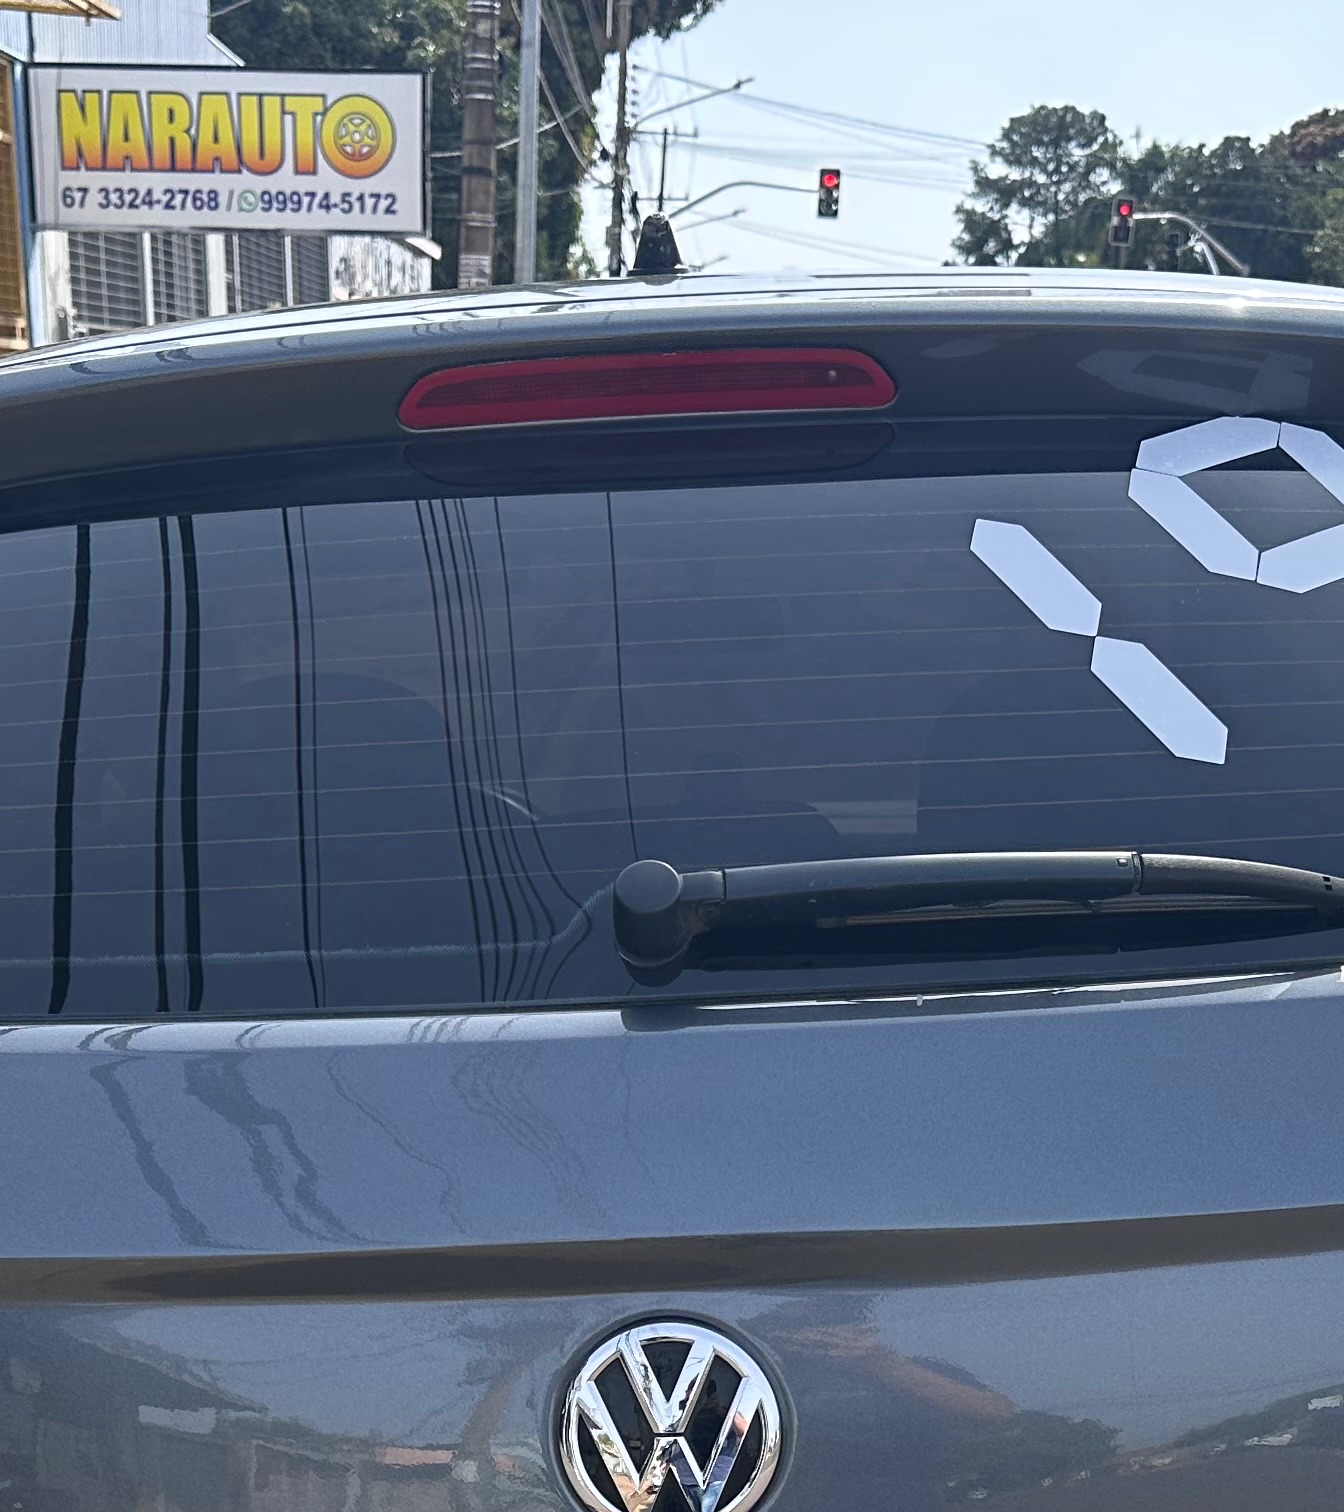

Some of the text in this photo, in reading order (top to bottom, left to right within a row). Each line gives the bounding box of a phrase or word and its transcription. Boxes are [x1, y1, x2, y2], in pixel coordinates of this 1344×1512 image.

[58, 89, 397, 179] NARAUTO
[62, 187, 89, 209] 67
[96, 188, 219, 212] 3324-2768
[259, 190, 399, 216] 99974-5172
